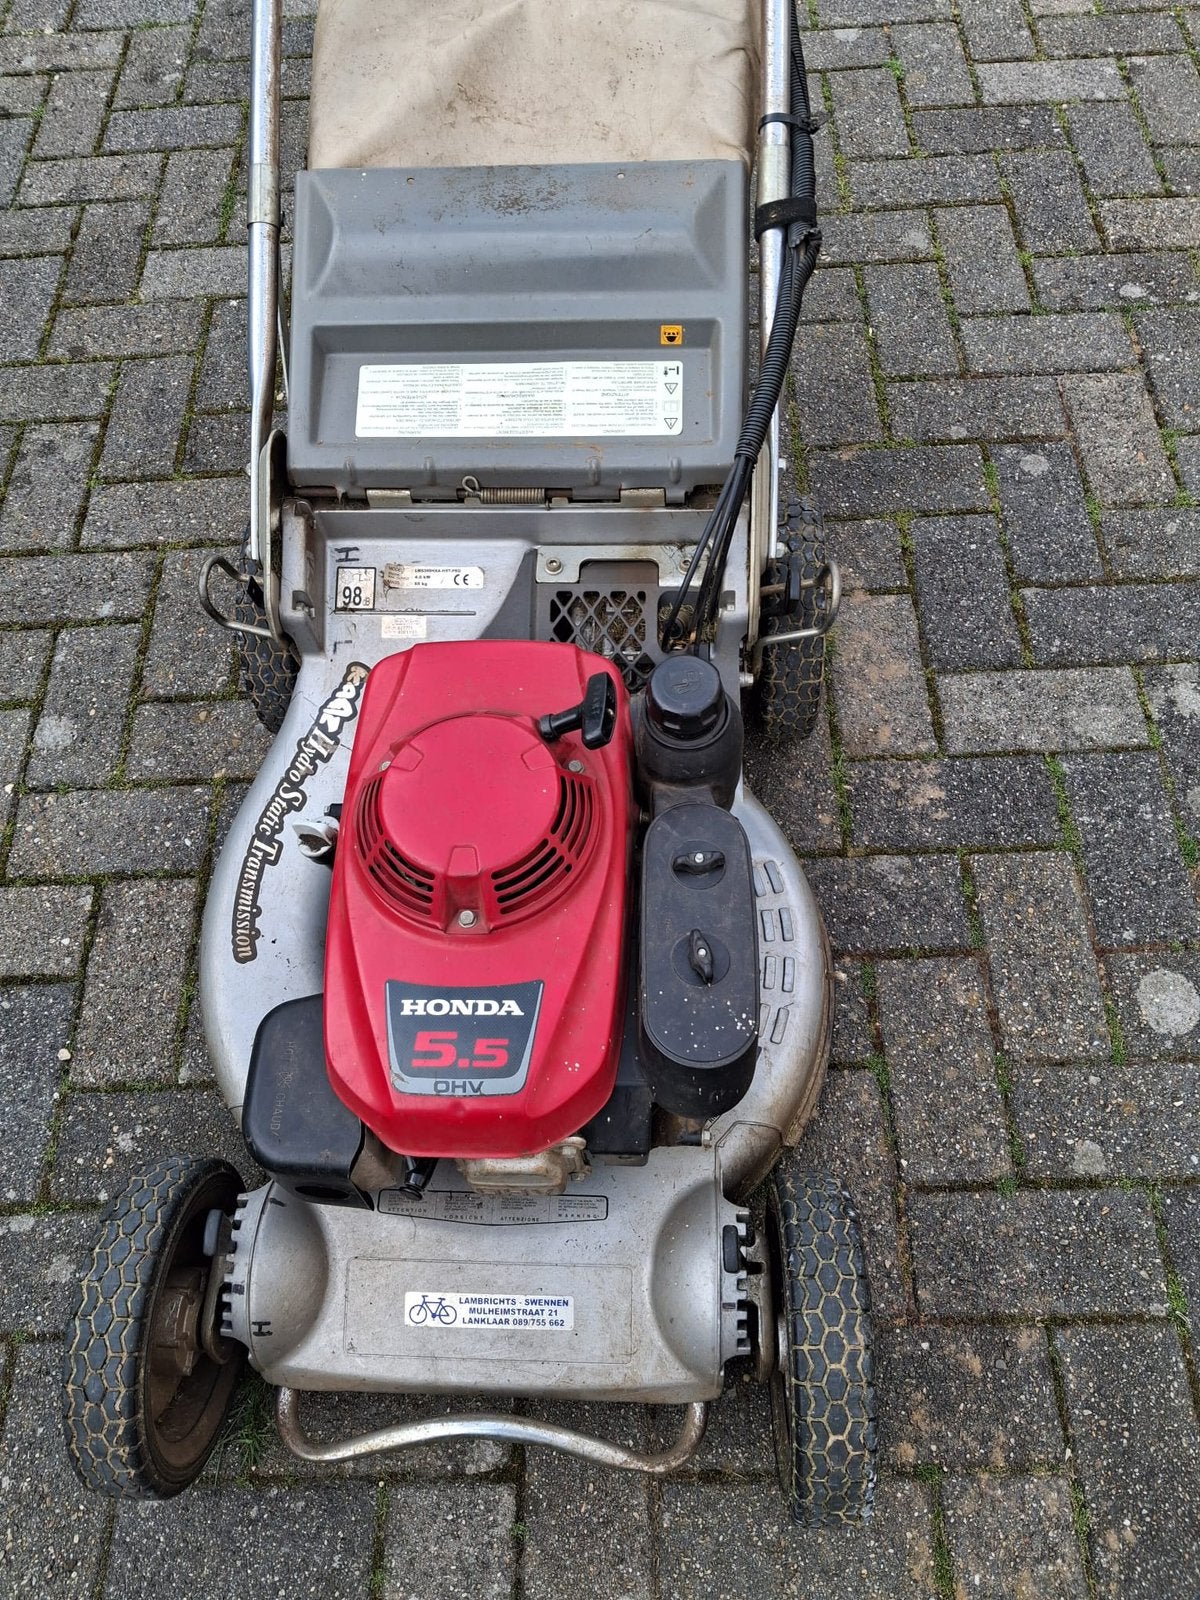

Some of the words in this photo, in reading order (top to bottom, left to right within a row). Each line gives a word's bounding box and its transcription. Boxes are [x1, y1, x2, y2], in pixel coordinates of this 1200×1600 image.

[342, 586, 362, 606] 98
[289, 727, 335, 782] Hydro
[259, 782, 303, 836] Static
[235, 838, 279, 959] Transmission
[400, 998, 525, 1016] HONDA
[411, 1031, 510, 1069] 5.5
[433, 1080, 485, 1094] OHV
[458, 1297, 517, 1306] LAMBRICHTS
[524, 1298, 569, 1307] SWENNEN
[468, 1307, 545, 1316] MULHEIMSTRAAT
[547, 1309, 558, 1317] 21
[462, 1317, 510, 1326] LANKLAAR
[512, 1318, 547, 1327] 089/755
[548, 1319, 565, 1327] 662
